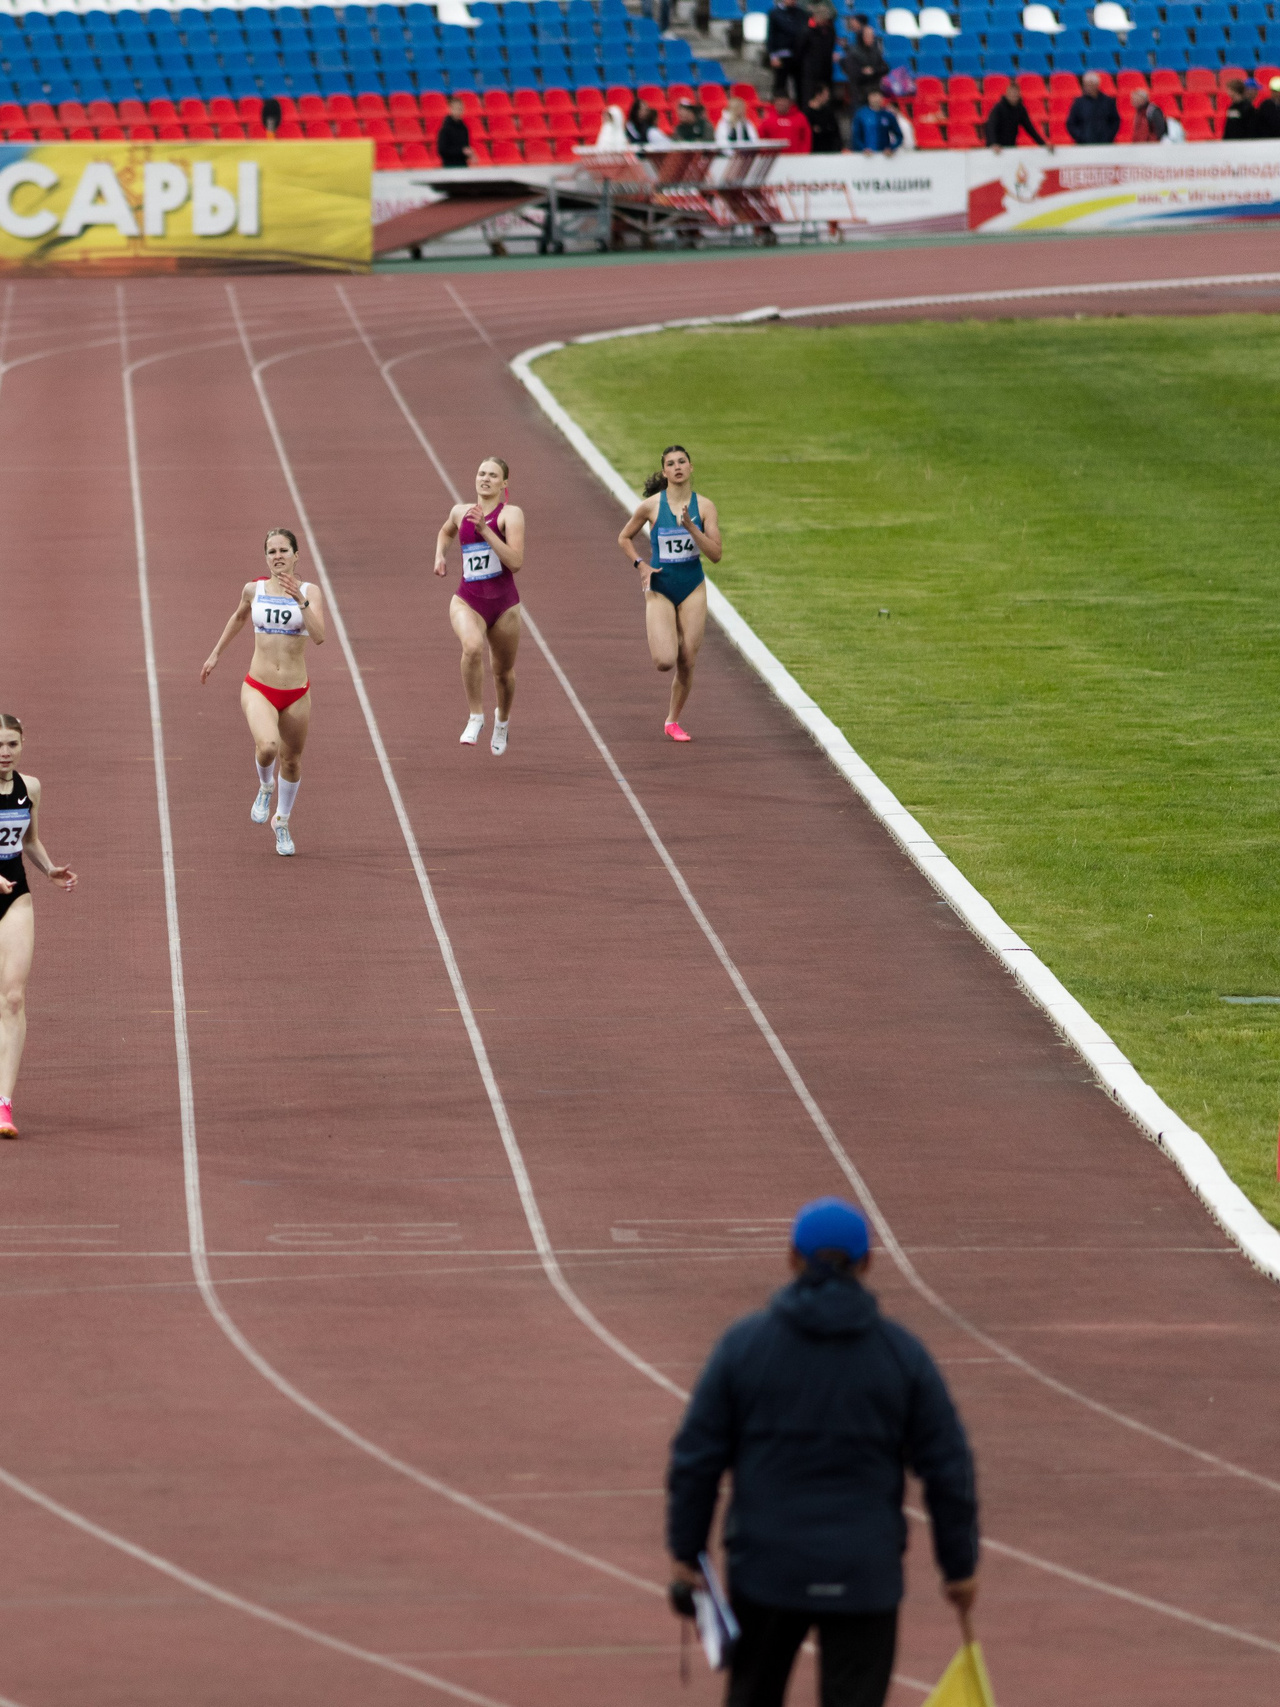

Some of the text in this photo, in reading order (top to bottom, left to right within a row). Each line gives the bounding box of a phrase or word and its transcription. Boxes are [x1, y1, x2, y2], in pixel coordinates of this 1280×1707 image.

[851, 178, 932, 192] ЧУВАШИИ
[665, 538, 694, 553] 134
[468, 554, 490, 572] 127
[265, 608, 292, 625] 119
